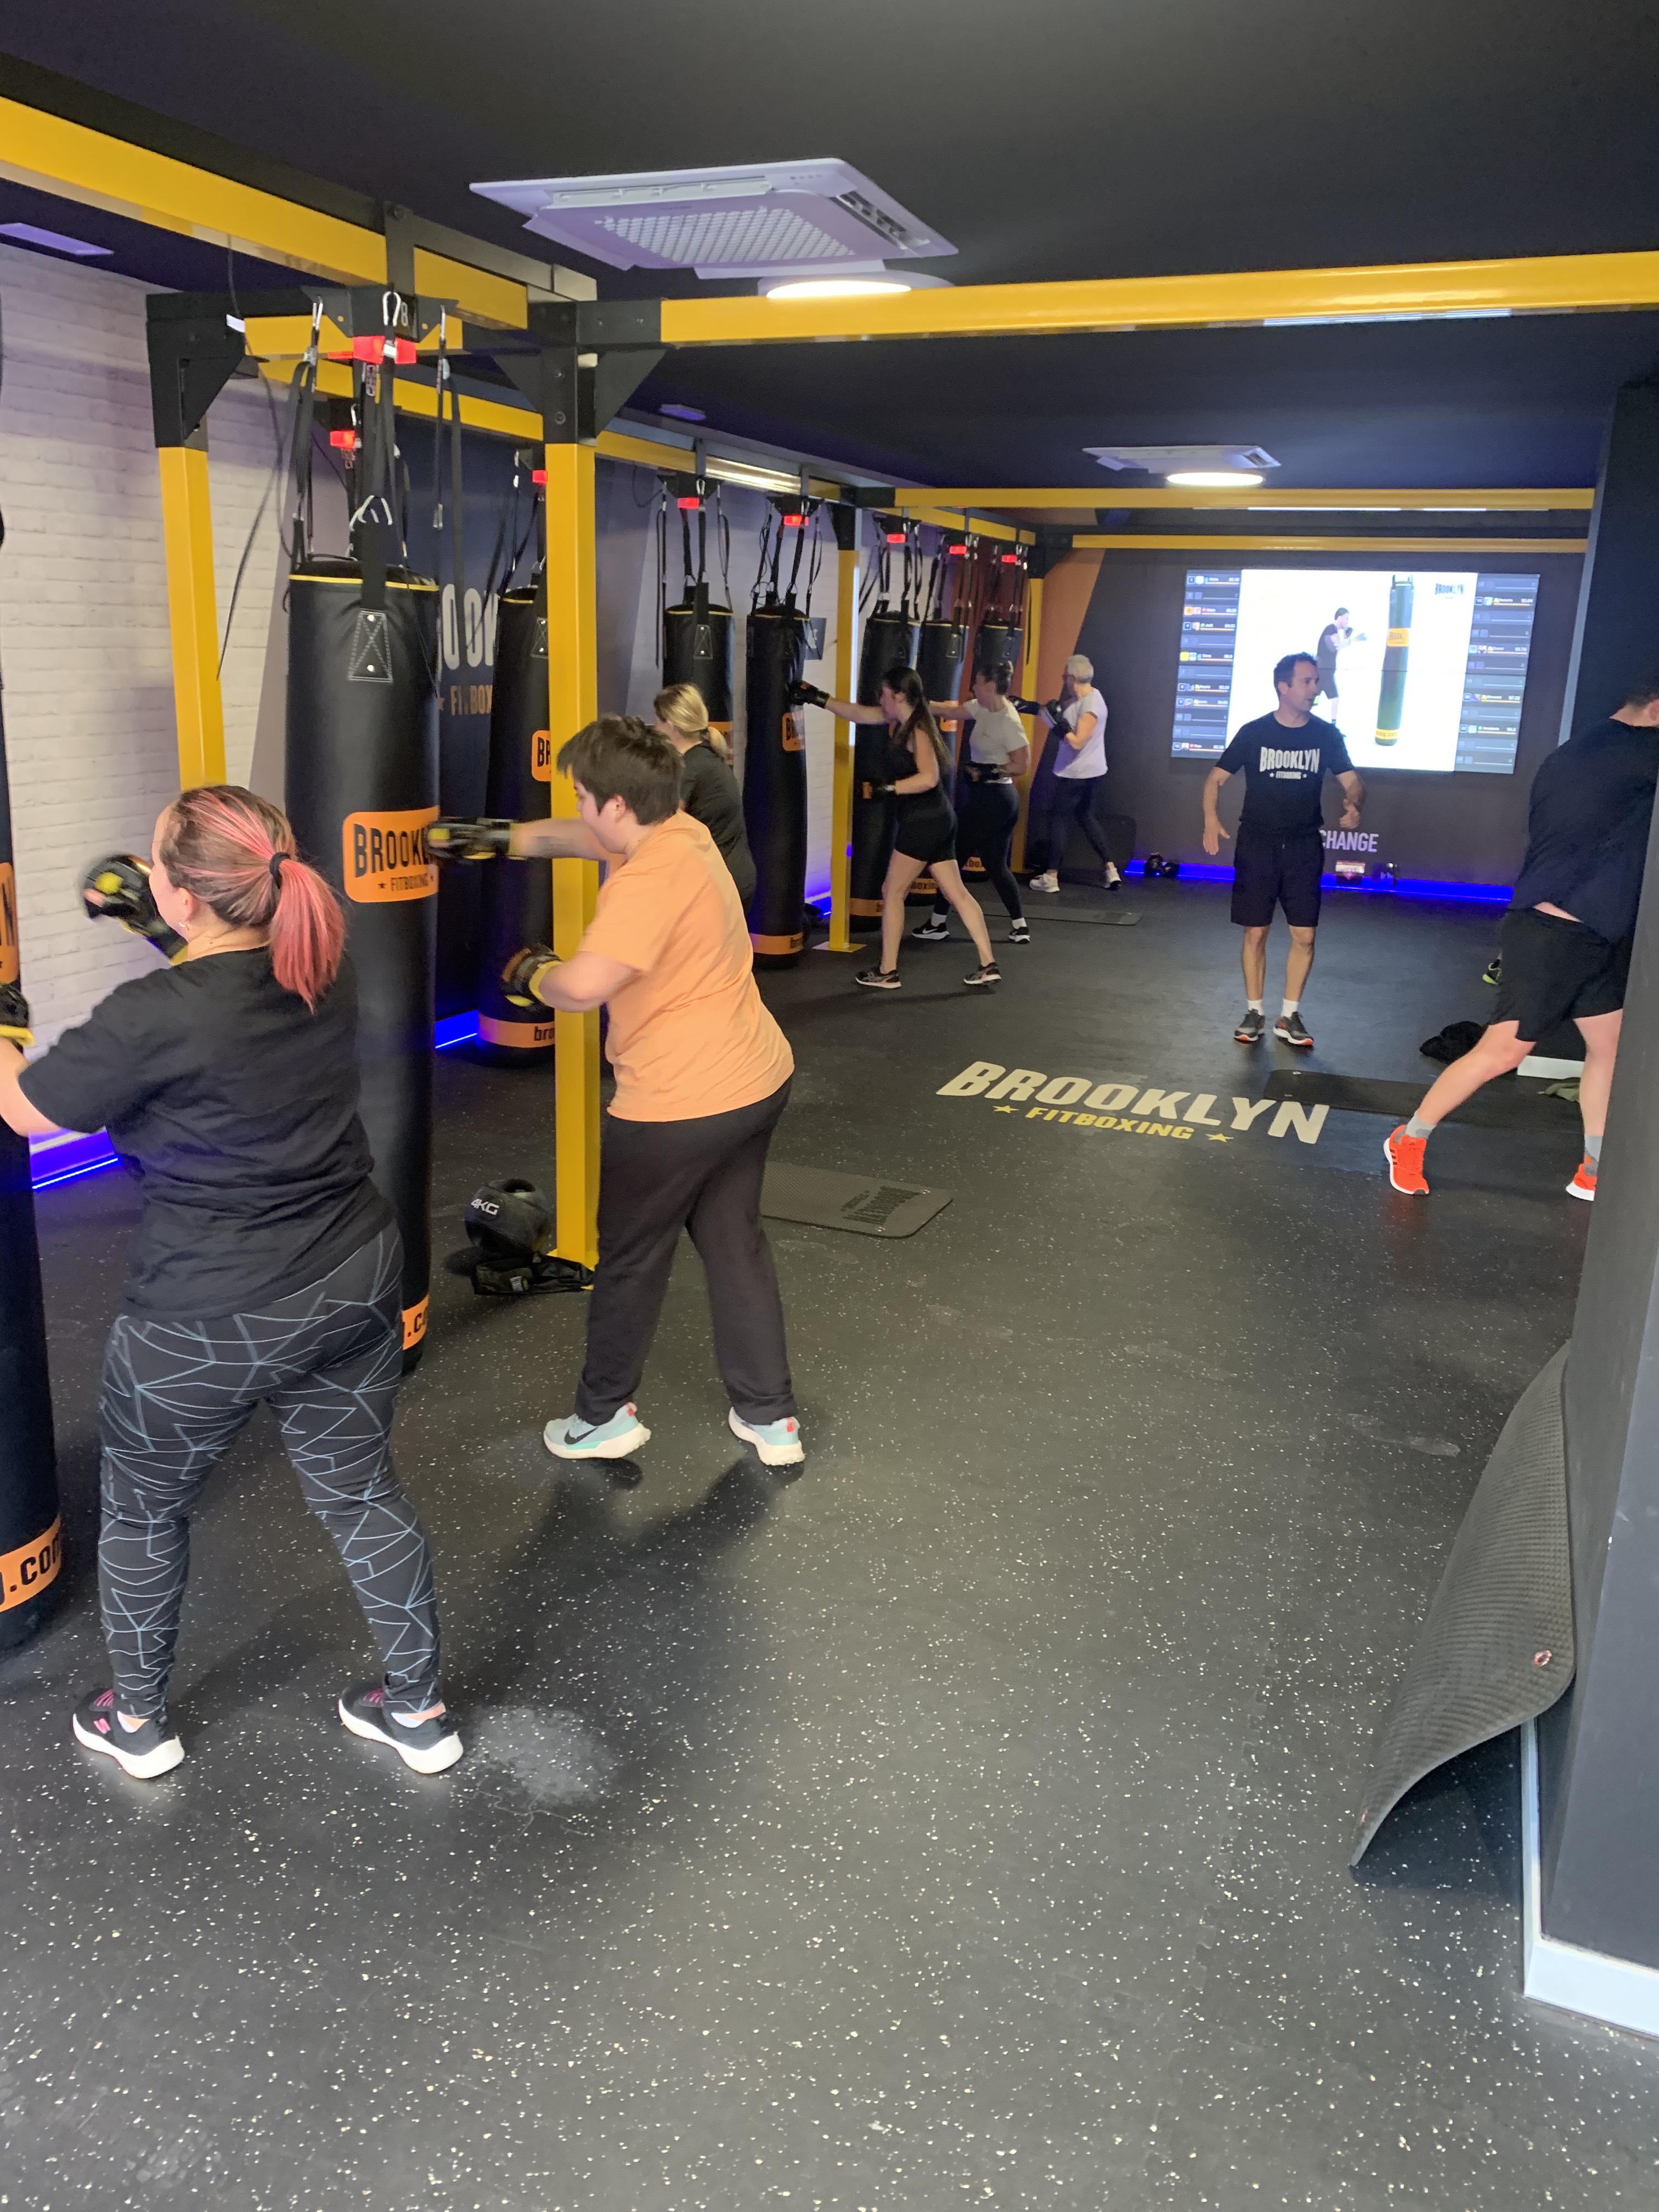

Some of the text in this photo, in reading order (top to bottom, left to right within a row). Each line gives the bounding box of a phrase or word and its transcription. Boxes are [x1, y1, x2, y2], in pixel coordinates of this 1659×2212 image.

[1260, 746, 1320, 774] BROOKLYN
[936, 1061, 1330, 1144] BROOKLYN
[1025, 1106, 1195, 1140] FITBOXING
[471, 1198, 500, 1215] 4KG
